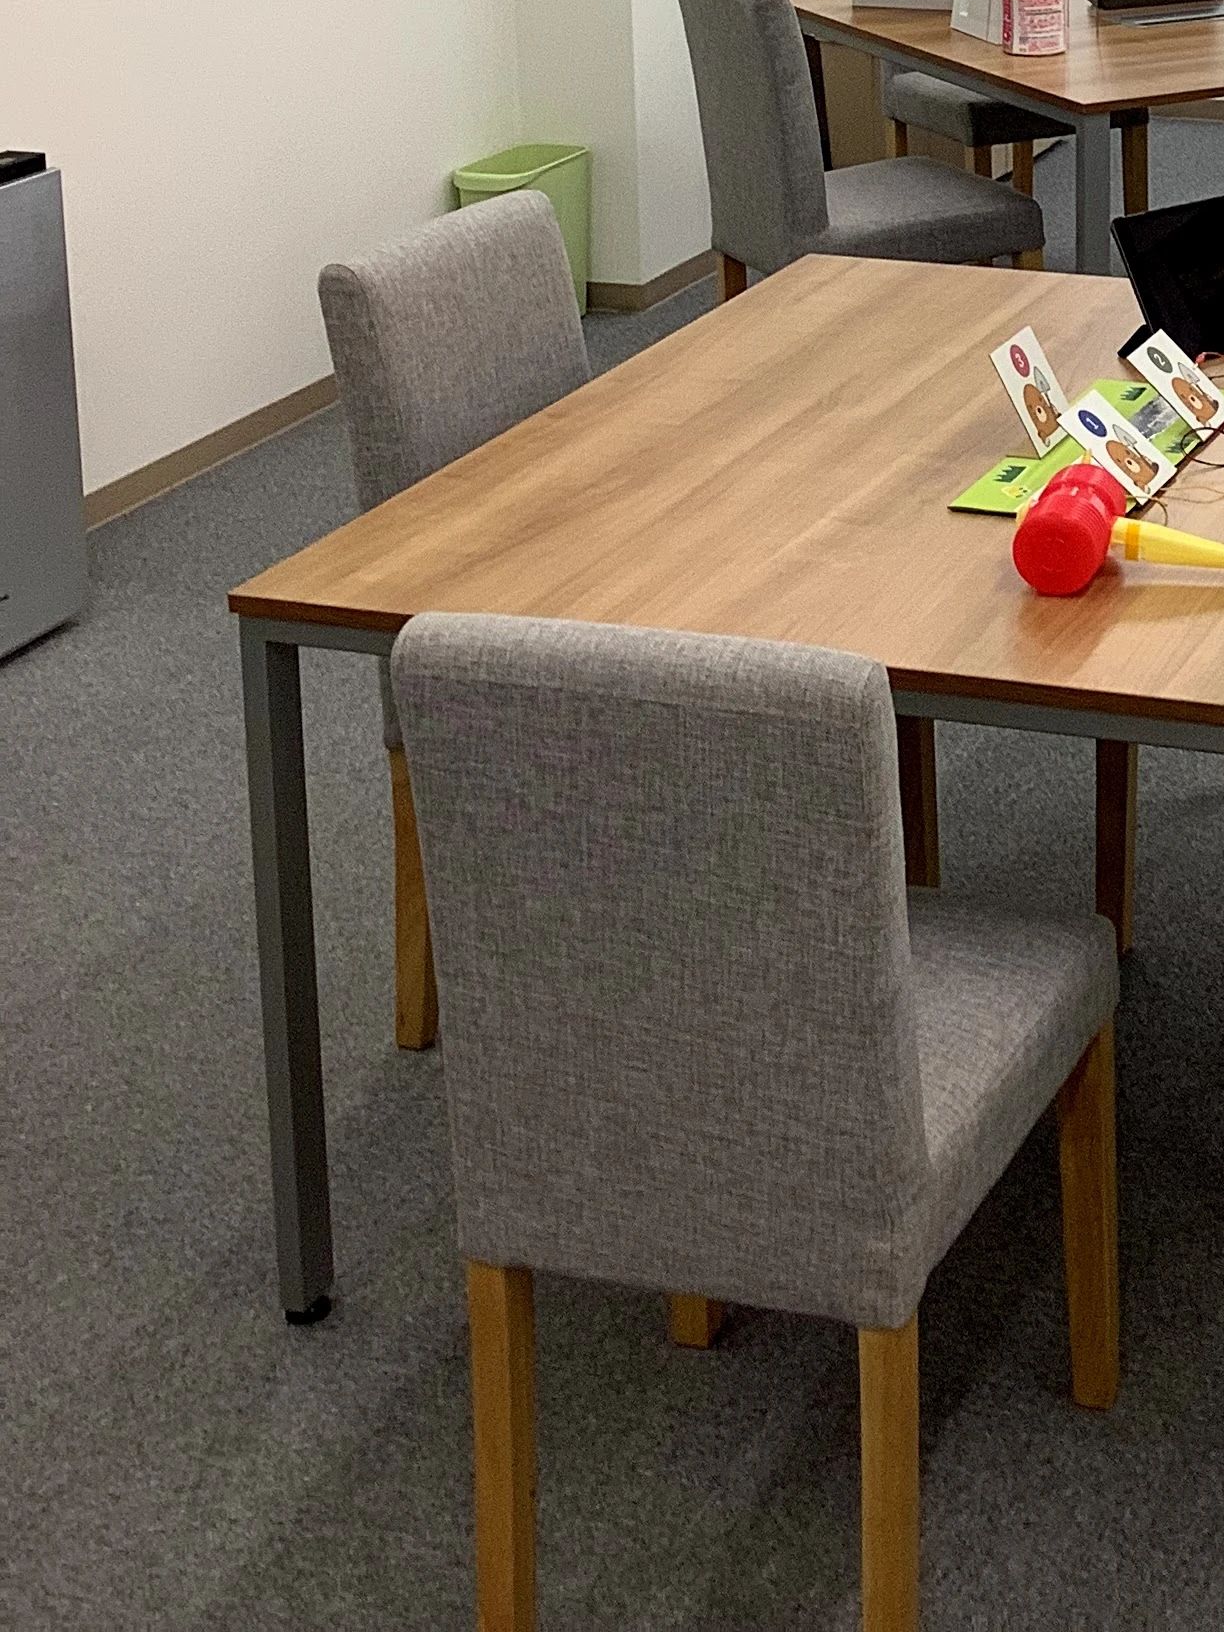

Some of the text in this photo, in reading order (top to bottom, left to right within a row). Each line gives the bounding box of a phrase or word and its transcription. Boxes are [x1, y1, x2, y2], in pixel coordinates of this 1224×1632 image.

[1015, 352, 1025, 368] 3
[1153, 353, 1166, 367] 2
[1086, 417, 1099, 430] 1
